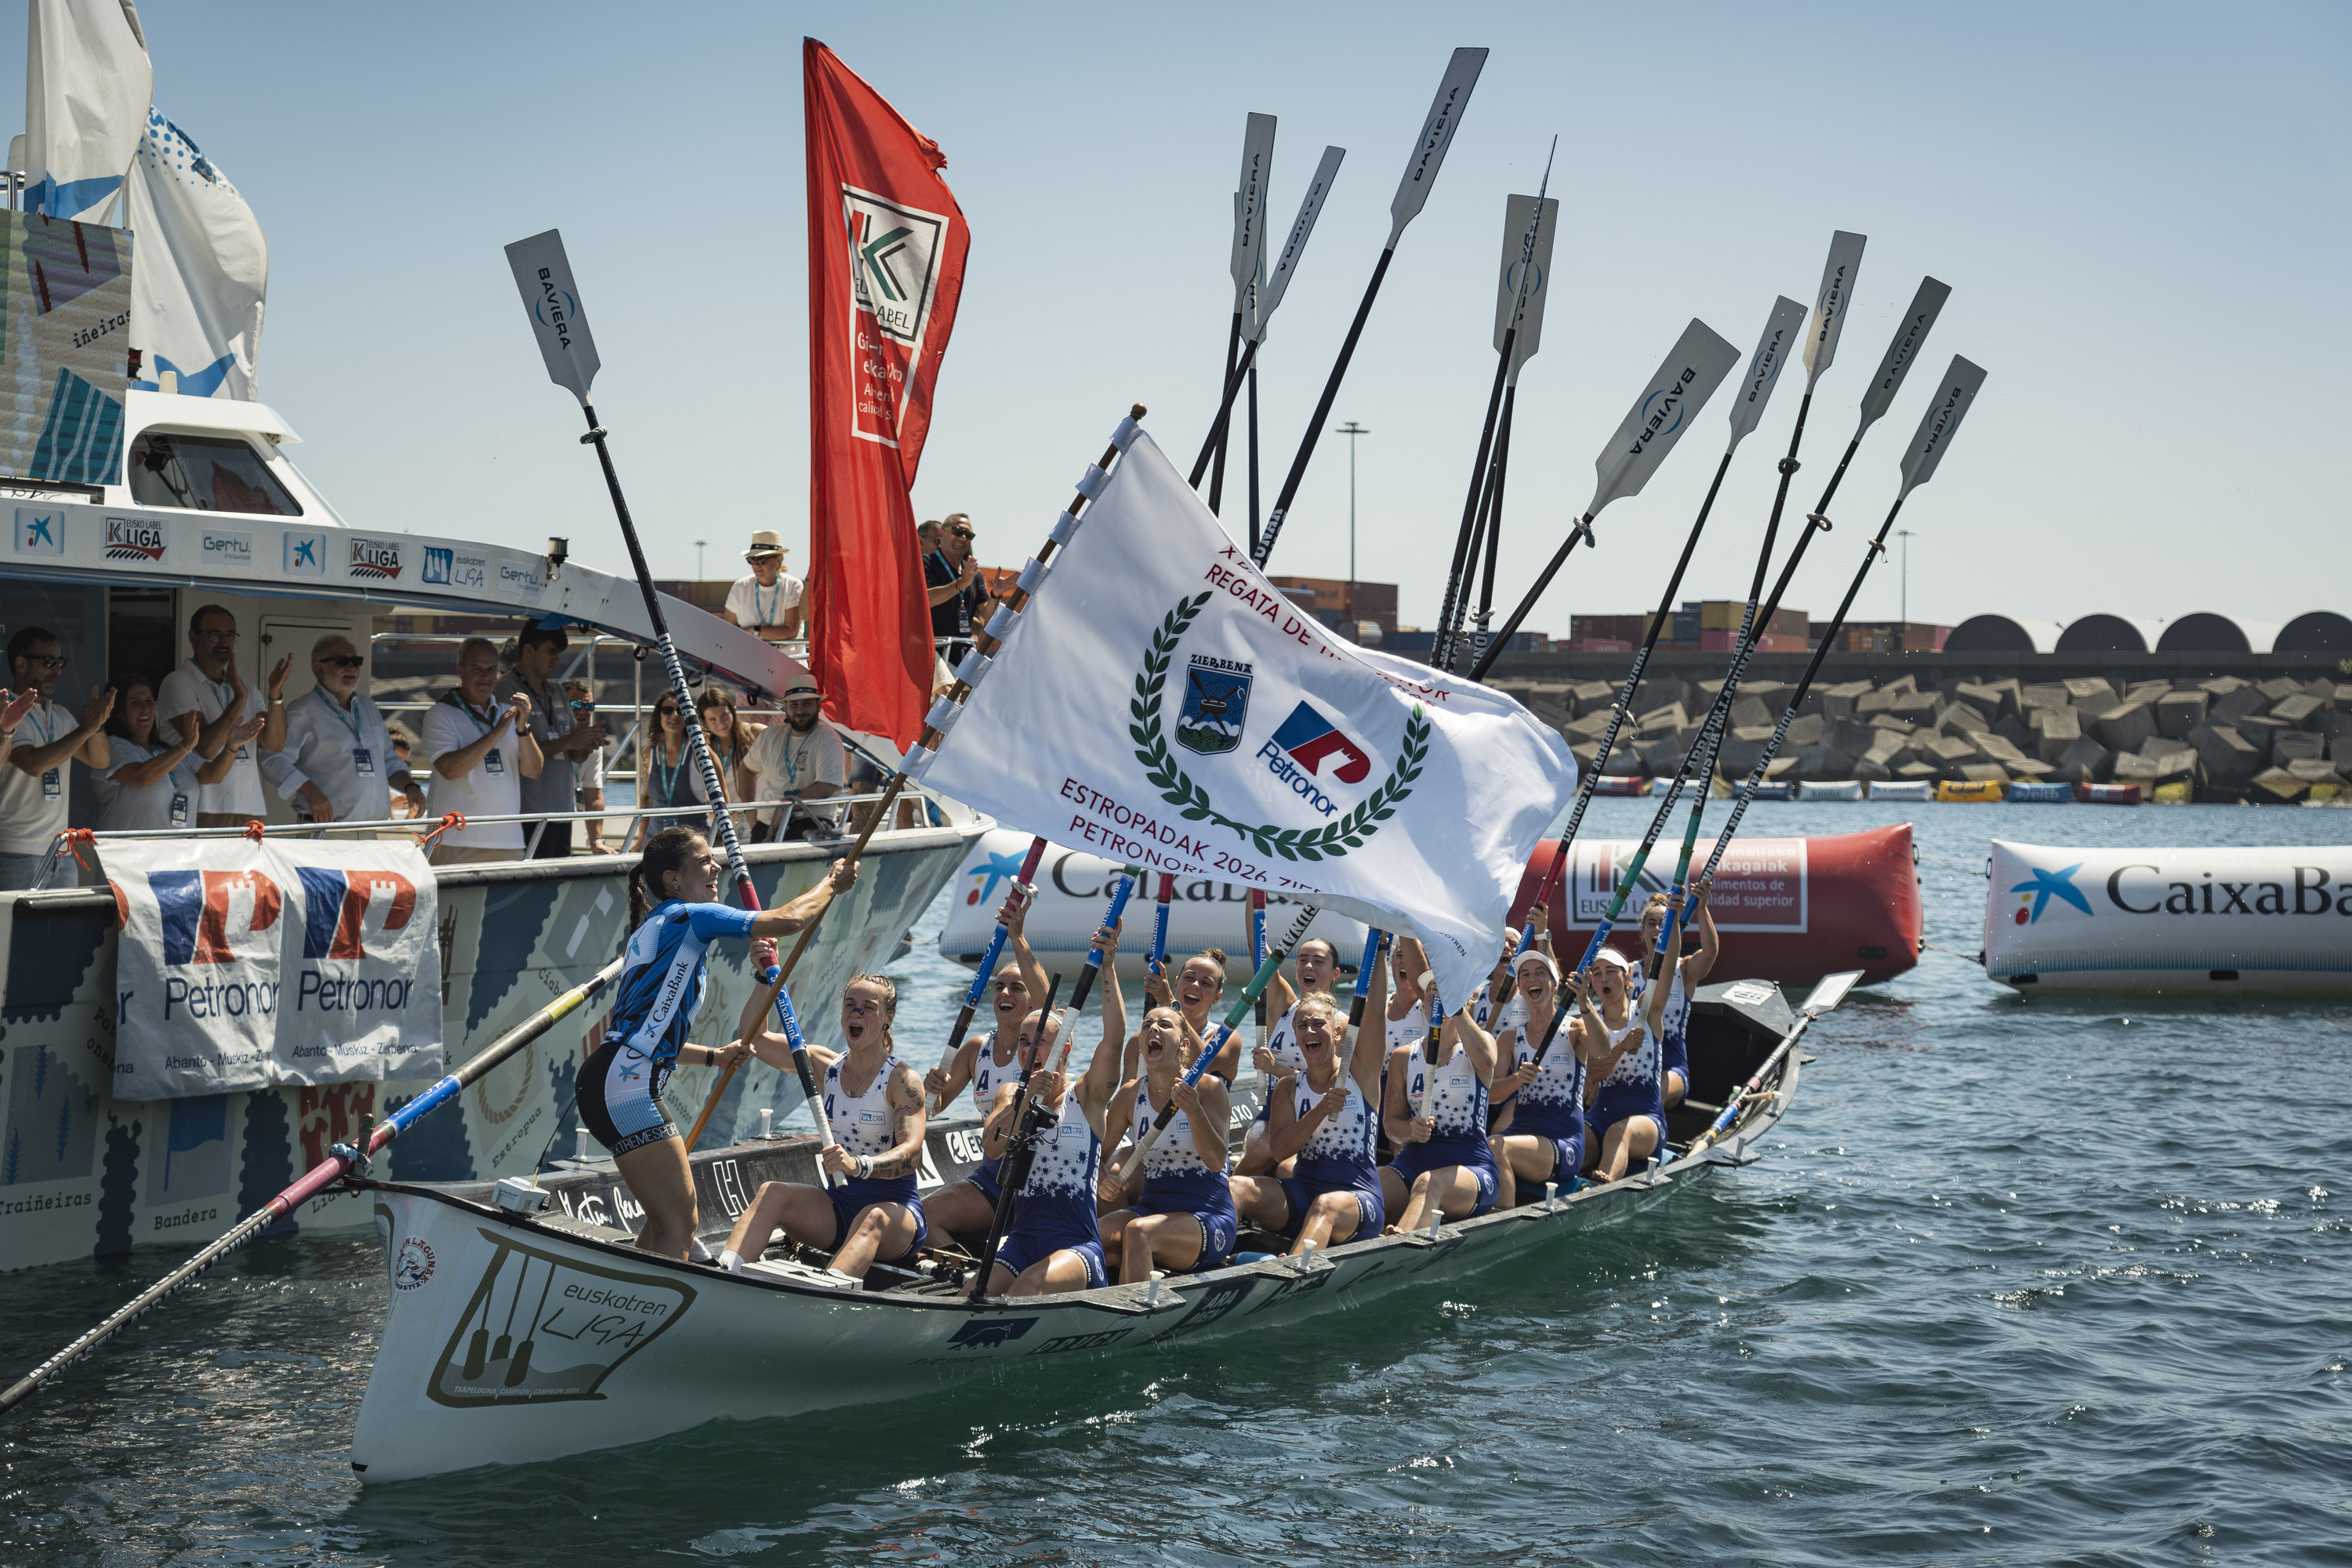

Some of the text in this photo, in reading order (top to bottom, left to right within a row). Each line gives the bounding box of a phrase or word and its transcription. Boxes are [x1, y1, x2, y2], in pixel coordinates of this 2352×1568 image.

[538, 267, 571, 350] BAVIERA
[1748, 329, 1784, 402] BAVIERA
[1629, 367, 1697, 455] BAVIERA
[1923, 387, 1962, 453] BAVIERA
[126, 519, 162, 530] EUSKO LABEL
[126, 530, 162, 548] LIGA
[368, 540, 400, 552] EUSKO LABEL
[368, 550, 399, 568] LIGA
[455, 568, 484, 587] LIGA
[456, 555, 485, 567] euskotren
[1204, 564, 1312, 646] REGATA DE
[658, 632, 750, 879] DONOSTIA ARRAUN LAGUNAK
[1757, 706, 1797, 775] DONOSTIA
[1256, 739, 1338, 818] Petronor
[1730, 774, 1762, 829] ARRAUN
[1060, 777, 1268, 883] ESTROPADAK 2026
[1698, 829, 1733, 884] LAGUNA
[1581, 899, 1628, 914] EUSO
[1710, 878, 1785, 891] limentos de
[1743, 894, 1794, 909] superior
[165, 977, 279, 1022] Petronor
[298, 970, 414, 1013] Petronor
[652, 961, 689, 1022] CaixaBank
[776, 988, 800, 1043] CaixaBank
[165, 1054, 207, 1070] Abanto
[218, 1051, 249, 1067] Muskiz
[292, 1044, 327, 1058] Abanto
[335, 1042, 368, 1056] Muskiz
[380, 1040, 417, 1055] Zierbena
[1367, 1111, 1378, 1167] asegi
[154, 1206, 218, 1231] Bandera
[412, 1236, 436, 1284] LAGUNAK
[564, 1283, 668, 1316] euskotren
[540, 1307, 648, 1348] LIGA
[454, 1386, 497, 1396] TXAPELDUNA
